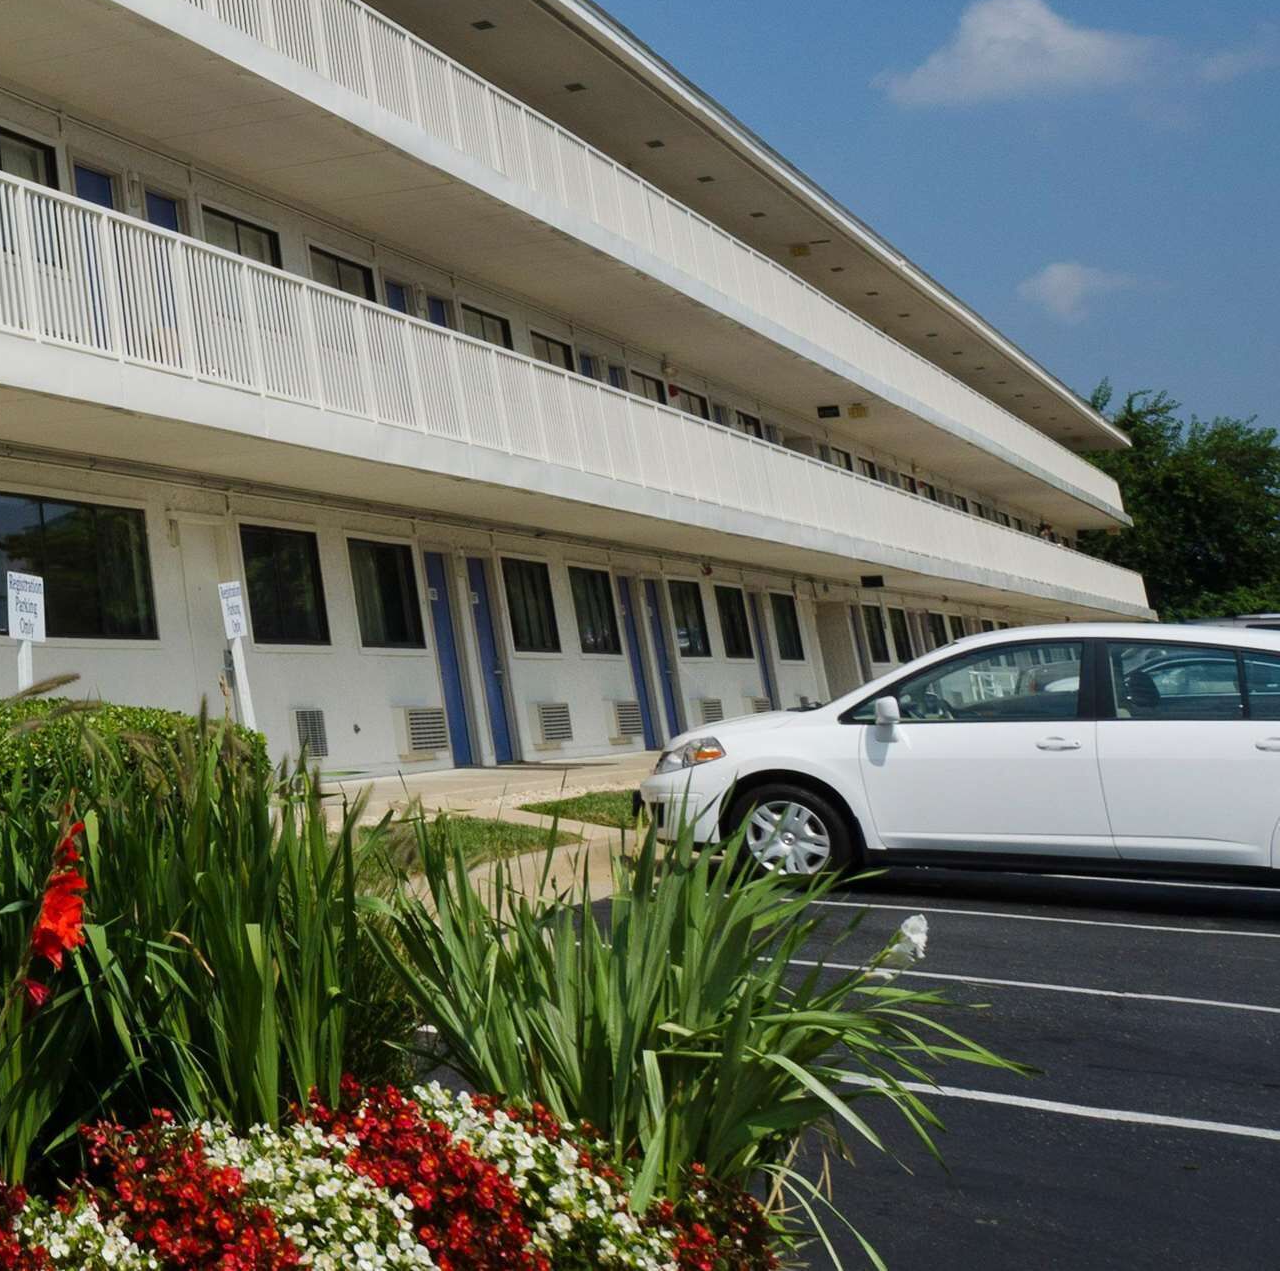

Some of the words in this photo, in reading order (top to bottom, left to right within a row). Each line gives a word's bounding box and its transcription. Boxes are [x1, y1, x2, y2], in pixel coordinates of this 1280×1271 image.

[9, 573, 43, 595] Registration
[15, 595, 38, 619] Parking
[19, 617, 35, 639] Only
